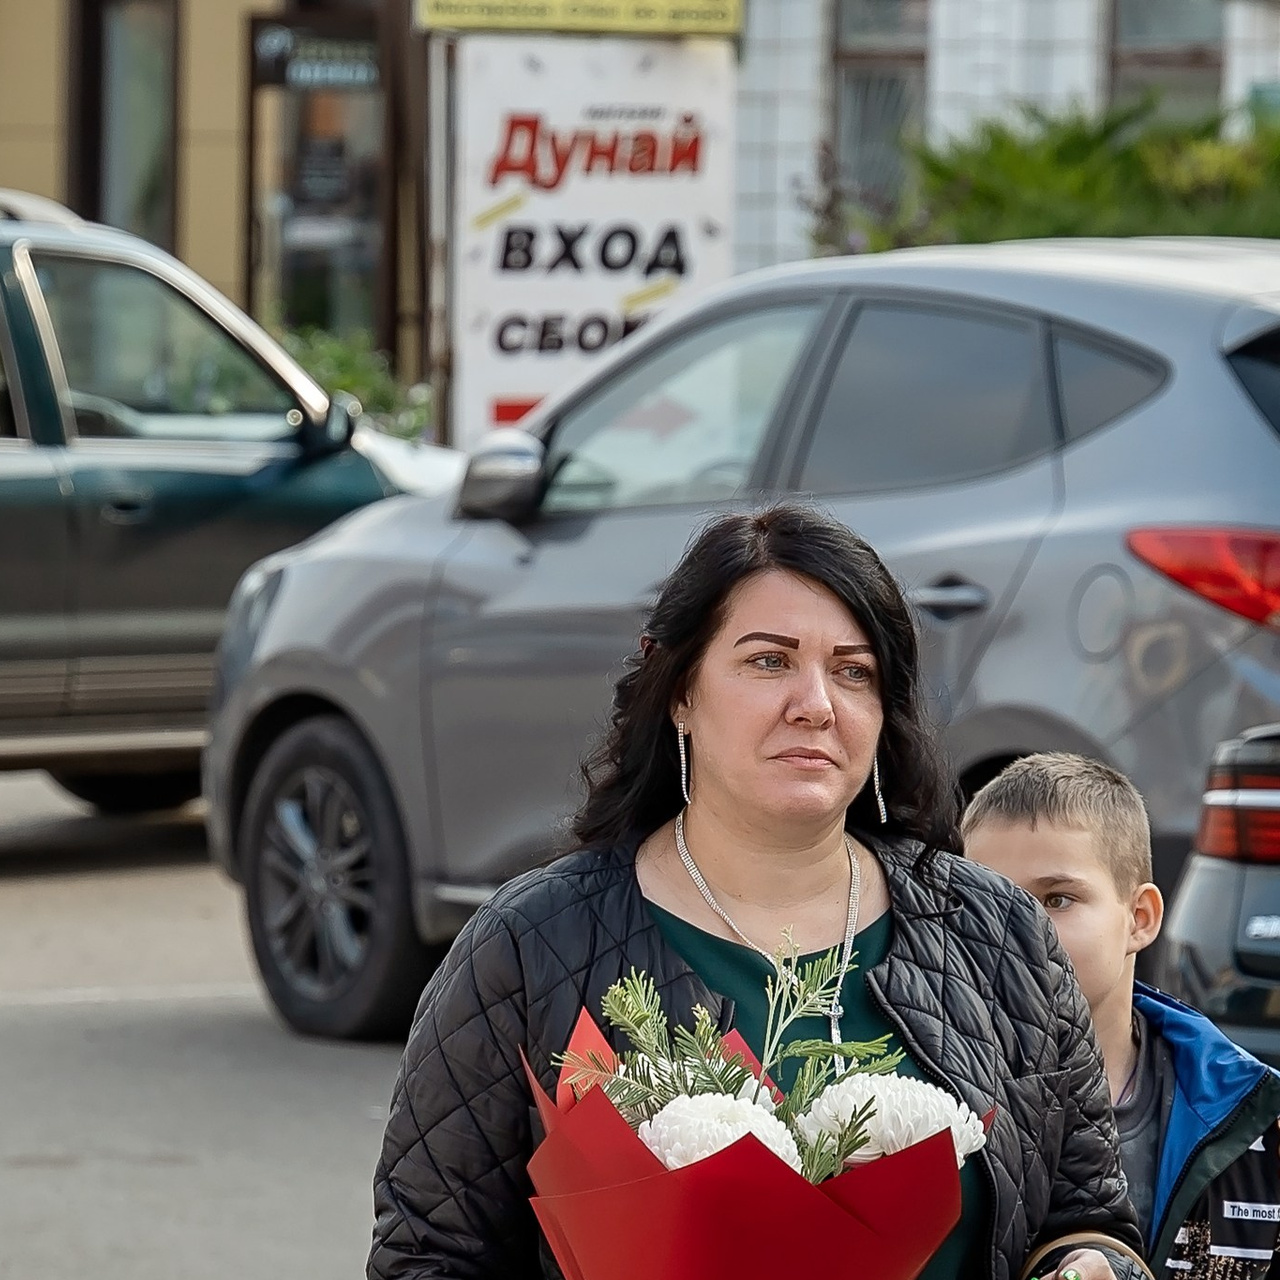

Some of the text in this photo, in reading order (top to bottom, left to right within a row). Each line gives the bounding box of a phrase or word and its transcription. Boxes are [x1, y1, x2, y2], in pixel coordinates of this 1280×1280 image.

[489, 113, 701, 189] Дунай
[499, 226, 687, 277] ВХОД
[1230, 1205, 1249, 1217] The
[1252, 1208, 1275, 1219] most
